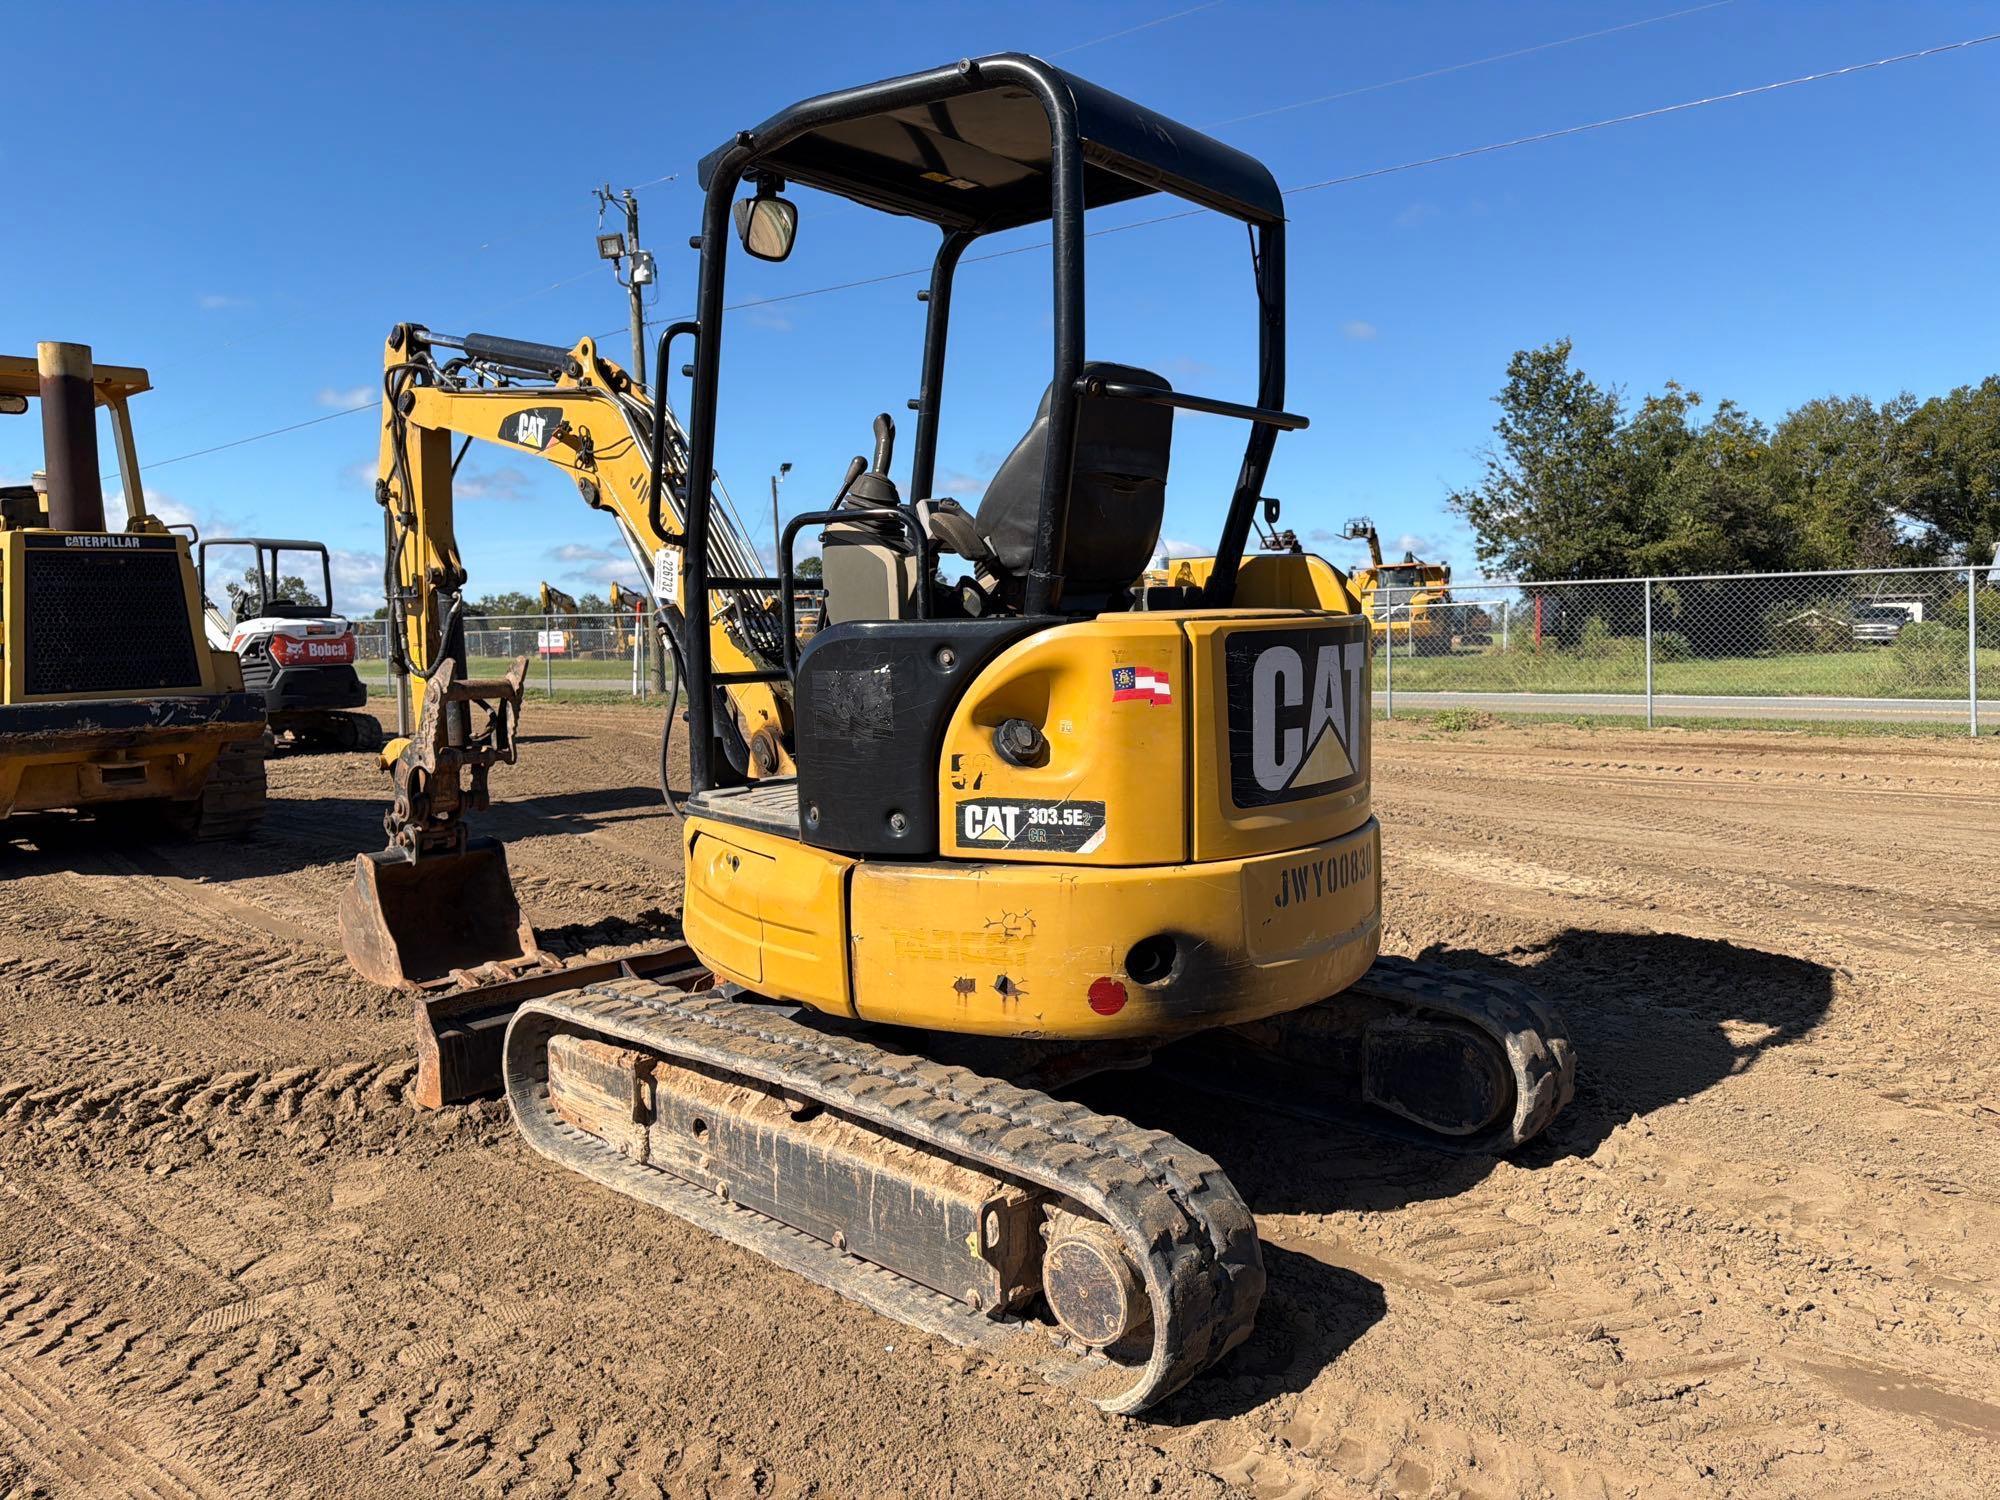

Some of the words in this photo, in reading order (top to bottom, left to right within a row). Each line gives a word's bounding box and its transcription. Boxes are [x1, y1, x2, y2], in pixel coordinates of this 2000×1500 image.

[518, 413, 546, 448] CAT
[65, 536, 140, 548] CATERPILLAR
[662, 560, 673, 593] 226732
[308, 643, 348, 657] Bobcat
[1253, 643, 1364, 791] CAT
[964, 804, 1020, 841] CAT
[1028, 827, 1047, 842] CR
[1275, 842, 1372, 908] JWY00830
